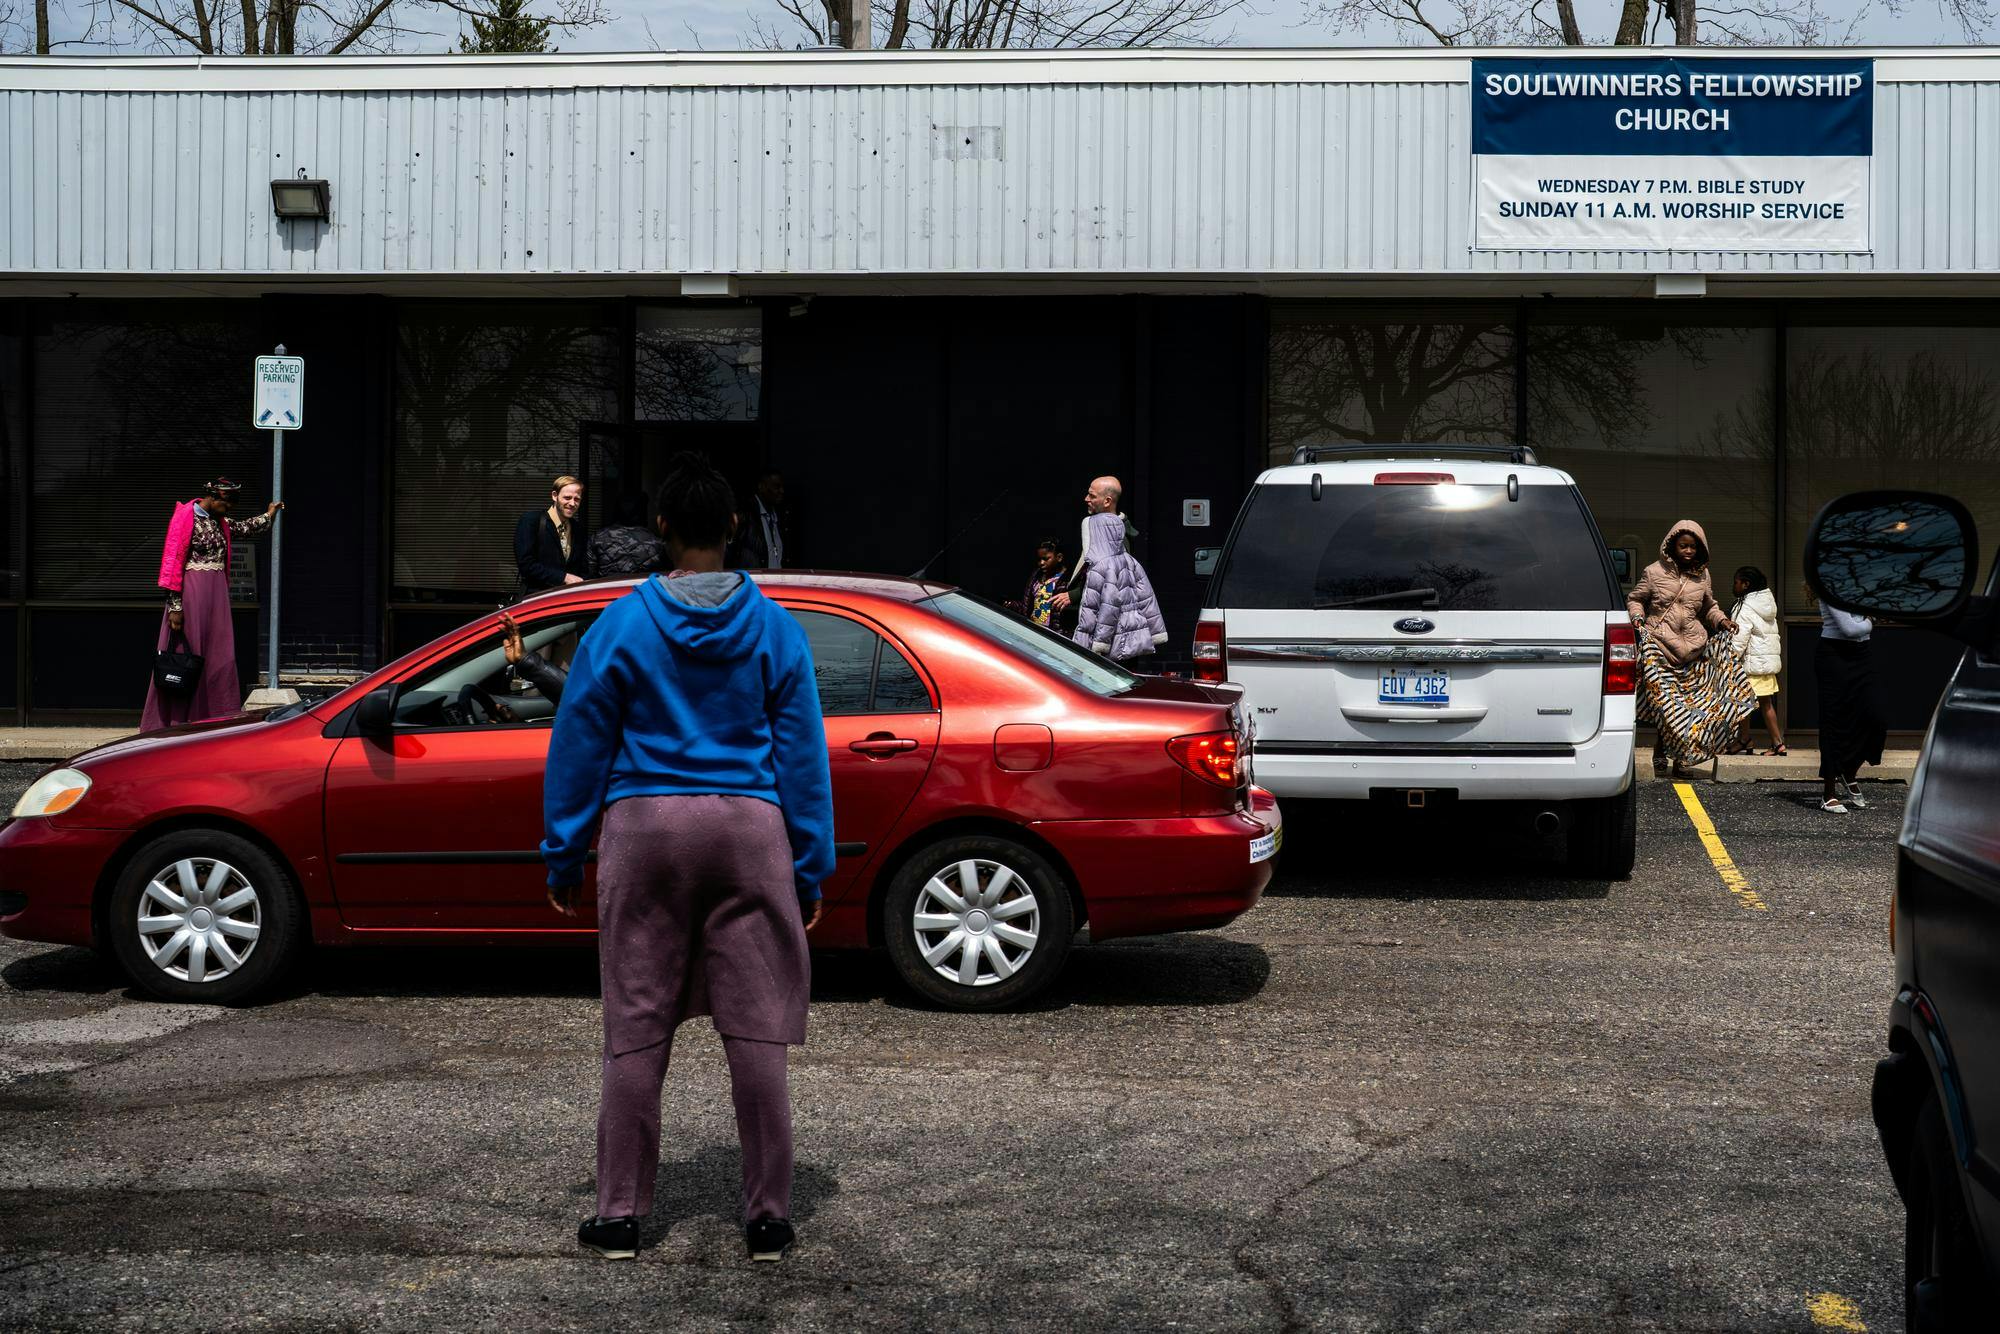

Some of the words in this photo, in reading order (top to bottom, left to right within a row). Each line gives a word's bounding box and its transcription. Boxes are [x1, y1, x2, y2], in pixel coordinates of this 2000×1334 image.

[1485, 73, 1681, 97] SOULWINNERS
[1689, 74, 1863, 97] FELLOWSHIP
[1615, 108, 1730, 131] CHURCH
[1537, 179, 1640, 194] WEDNESDAY
[1645, 180, 1655, 194] 7
[1659, 180, 1692, 194] P.M.
[1698, 180, 1745, 194] BIBLE
[1749, 180, 1806, 194] STUDY
[1499, 201, 1579, 218] SUNDAY
[1584, 202, 1606, 218] 11
[1612, 202, 1656, 219] A.M.
[1662, 202, 1755, 219] WORSHIP
[1761, 202, 1845, 219] SERVICE
[259, 364, 300, 373] RESERVED
[263, 374, 296, 383] PARKING
[1402, 618, 1426, 630] Ford
[1337, 649, 1492, 659] EXPEDITION
[1382, 676, 1406, 694] EQV
[1415, 676, 1447, 695] 4362
